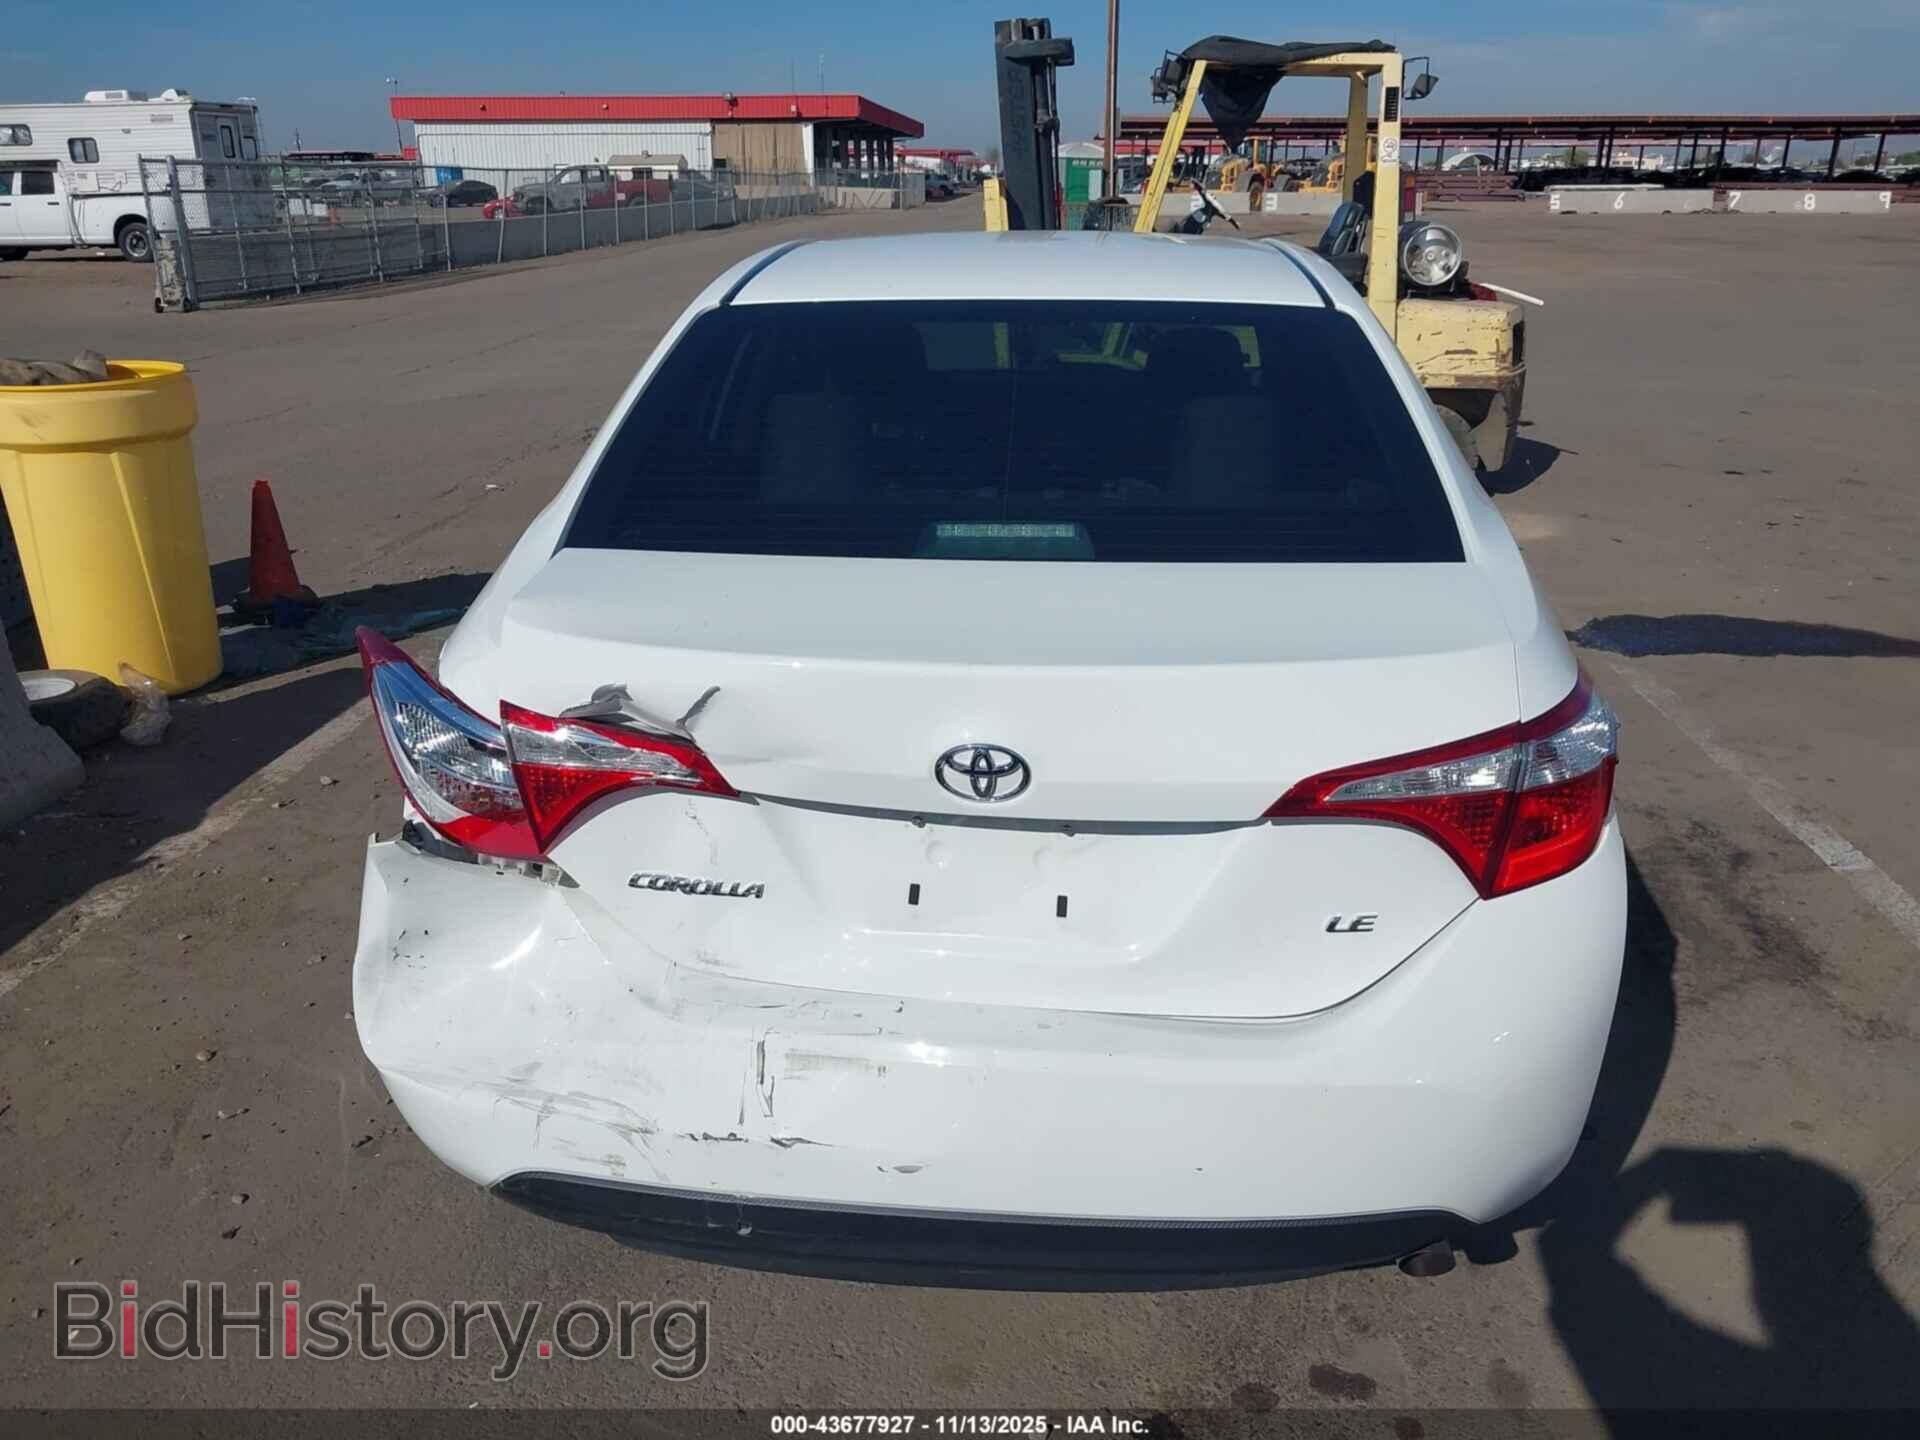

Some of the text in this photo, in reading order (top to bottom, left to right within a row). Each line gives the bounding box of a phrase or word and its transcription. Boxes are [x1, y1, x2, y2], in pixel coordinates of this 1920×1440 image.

[1264, 193, 1277, 210] 3
[1550, 192, 1626, 209] 5 6
[1729, 191, 1892, 210] 7 8 9
[627, 872, 765, 899] COROLLA
[1326, 913, 1378, 933] LE
